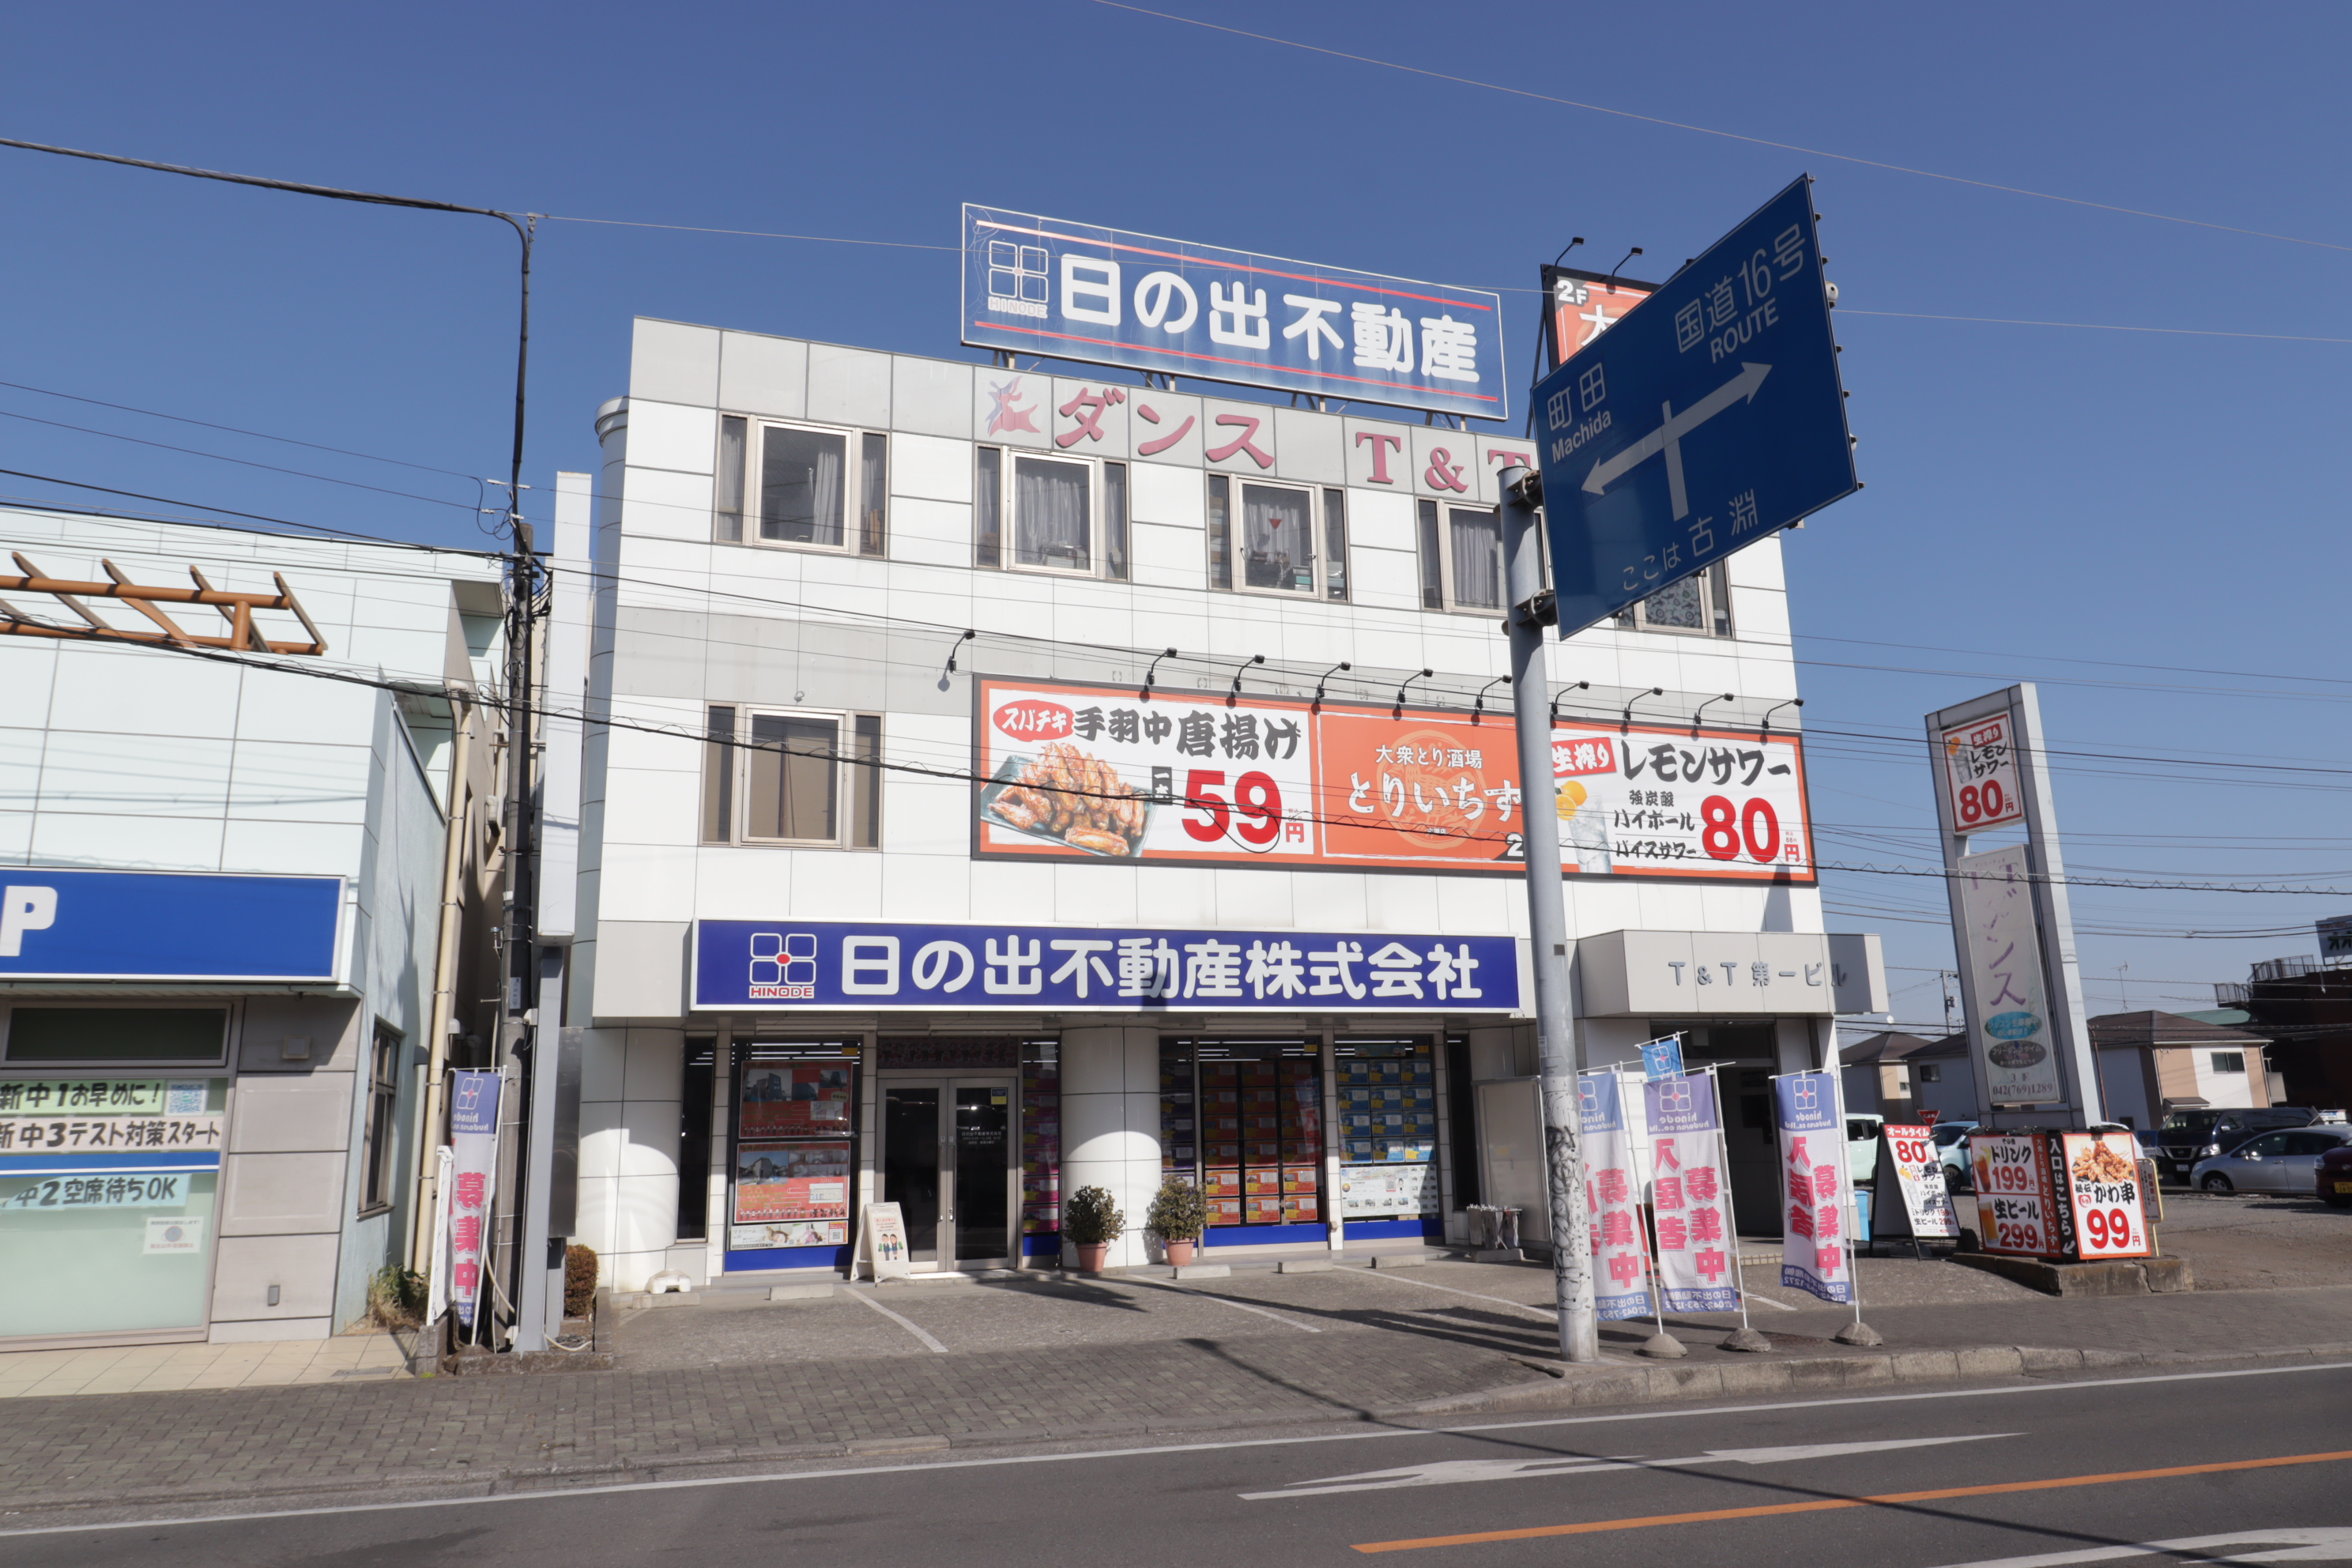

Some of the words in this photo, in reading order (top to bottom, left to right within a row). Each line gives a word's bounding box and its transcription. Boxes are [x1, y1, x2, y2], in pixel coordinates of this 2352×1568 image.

[1557, 279, 1588, 304] 2F
[1675, 224, 1805, 353] 国道16号
[988, 296, 1047, 318] HINODE
[1061, 253, 1479, 383] 日の出不動産
[1711, 298, 1779, 363] ROUTE
[1547, 362, 1606, 432] 町田
[1055, 387, 1274, 469] ダンス
[1552, 409, 1611, 463] Machida
[1072, 706, 1301, 760] 手羽中唐揚げ
[1376, 744, 1483, 769] 大衆とり酒場
[1621, 740, 1791, 786] レモンサワー
[1970, 741, 2007, 763] レモン
[1973, 759, 2009, 778] サワー
[1349, 771, 1521, 822] とりいちず
[1629, 790, 1674, 807] 強炭酸
[1615, 808, 1694, 831] ハイボール
[1616, 840, 1696, 860] バイスサワー
[0, 886, 58, 956] P
[842, 935, 1483, 999] 日の出不動産株式会社
[749, 986, 814, 998] HINODE
[1993, 1083, 2052, 1096] 042(769)1289
[1887, 1126, 1929, 1137] オールタイム
[1991, 1145, 2032, 1163] ドリンク
[1, 1176, 178, 1208] 中2空席待ちOK
[2050, 1139, 2071, 1236] 入口はこちら
[2094, 1181, 2135, 1204] かわ串
[1994, 1198, 2040, 1220] 生ビール
[2043, 1185, 2058, 1246] とりいちず
